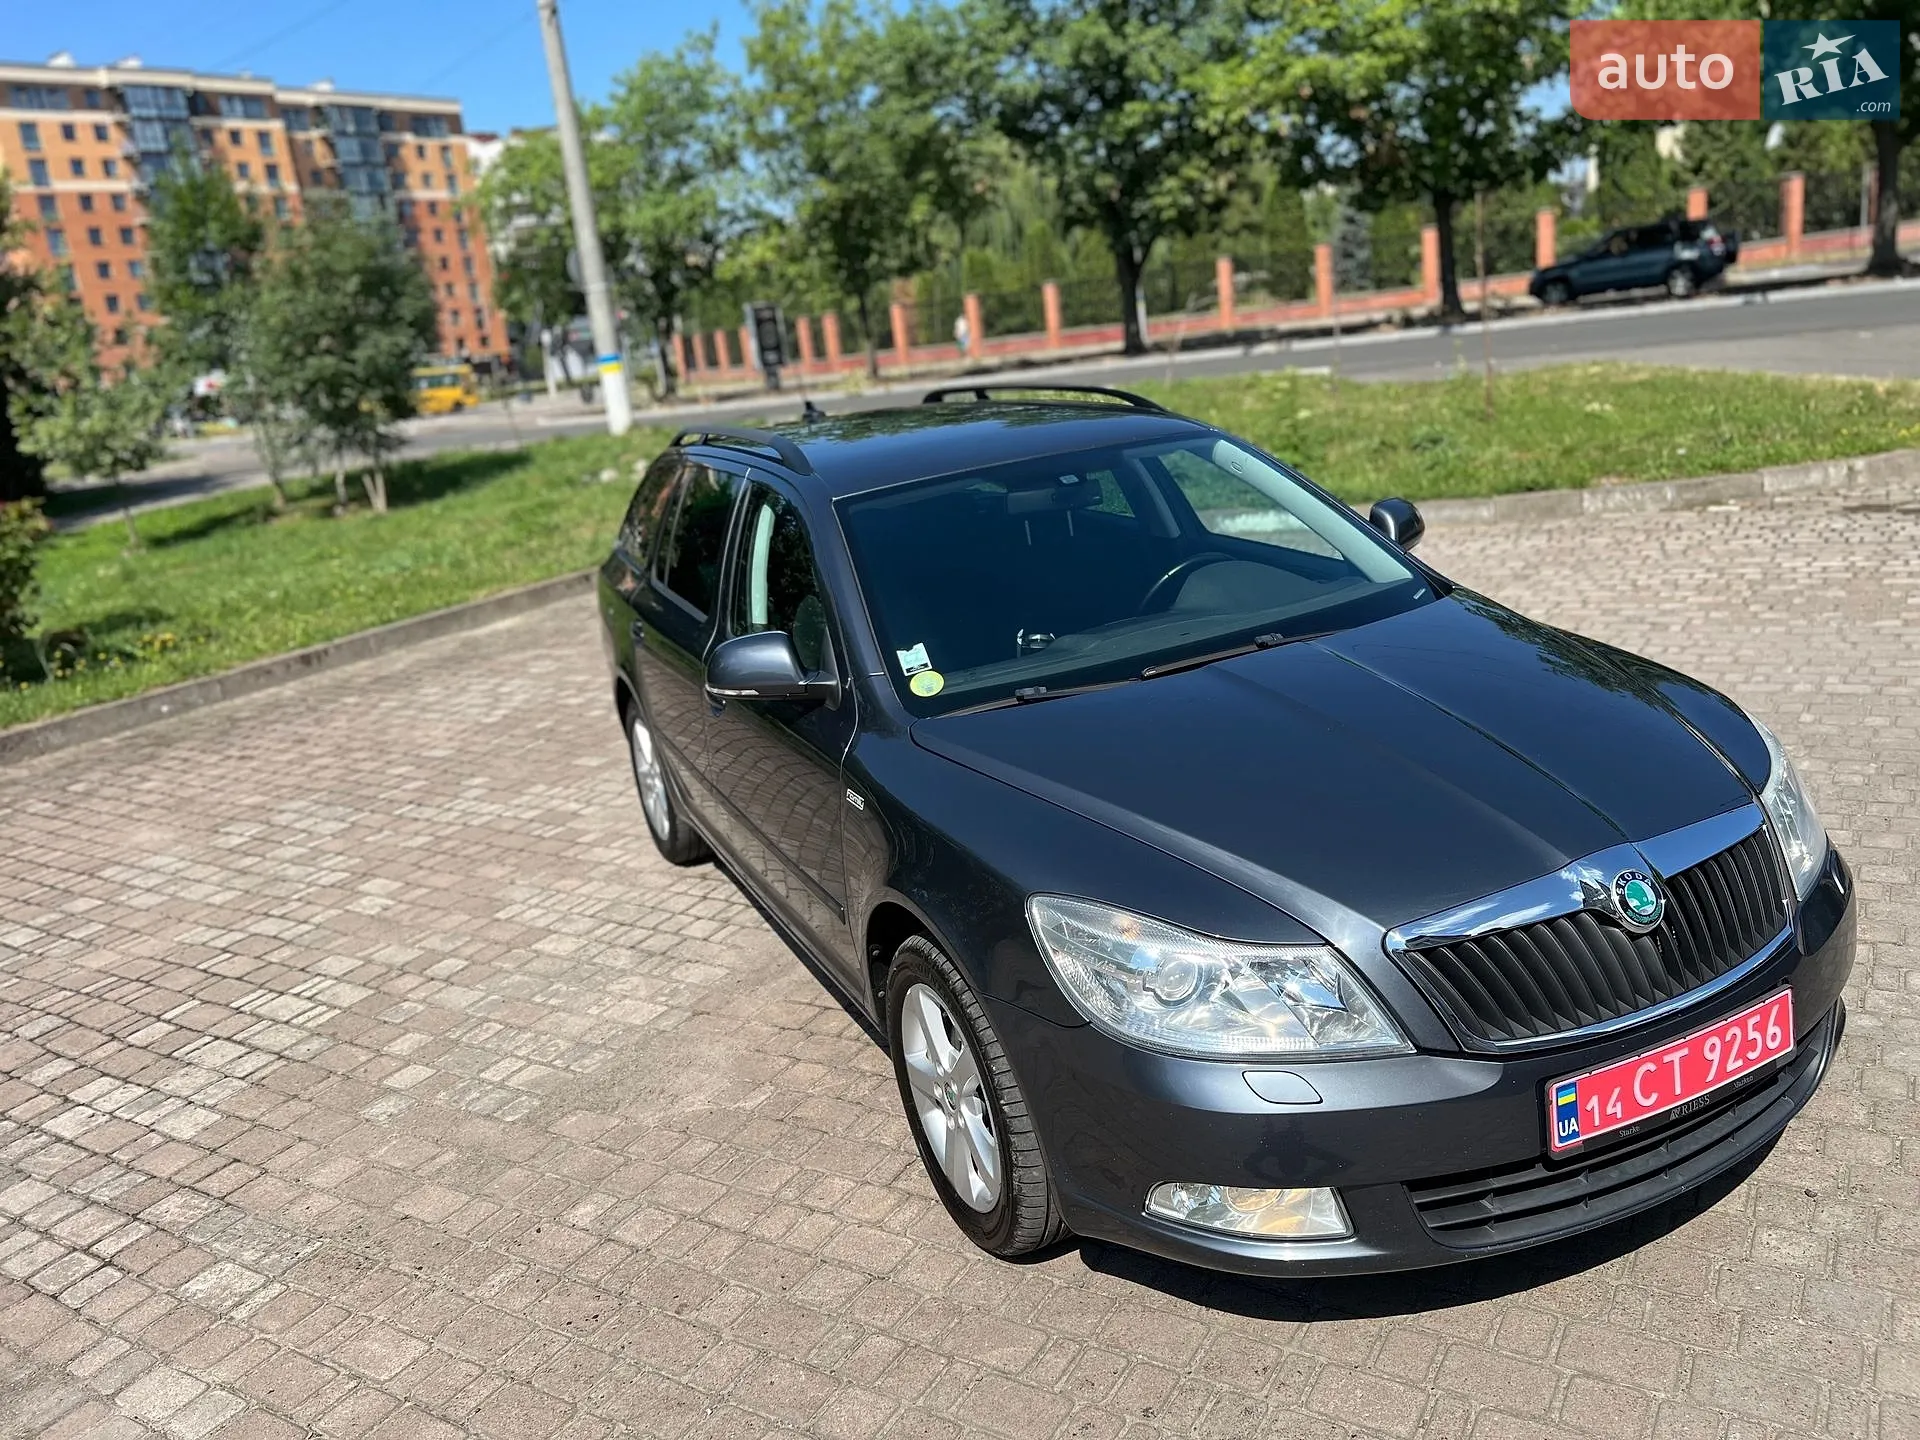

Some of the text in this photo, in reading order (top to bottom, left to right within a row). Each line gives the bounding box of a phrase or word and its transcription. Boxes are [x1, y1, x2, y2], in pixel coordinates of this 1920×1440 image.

[1585, 1004, 1783, 1127] 14 CT 9256
[1559, 1116, 1579, 1138] UA
